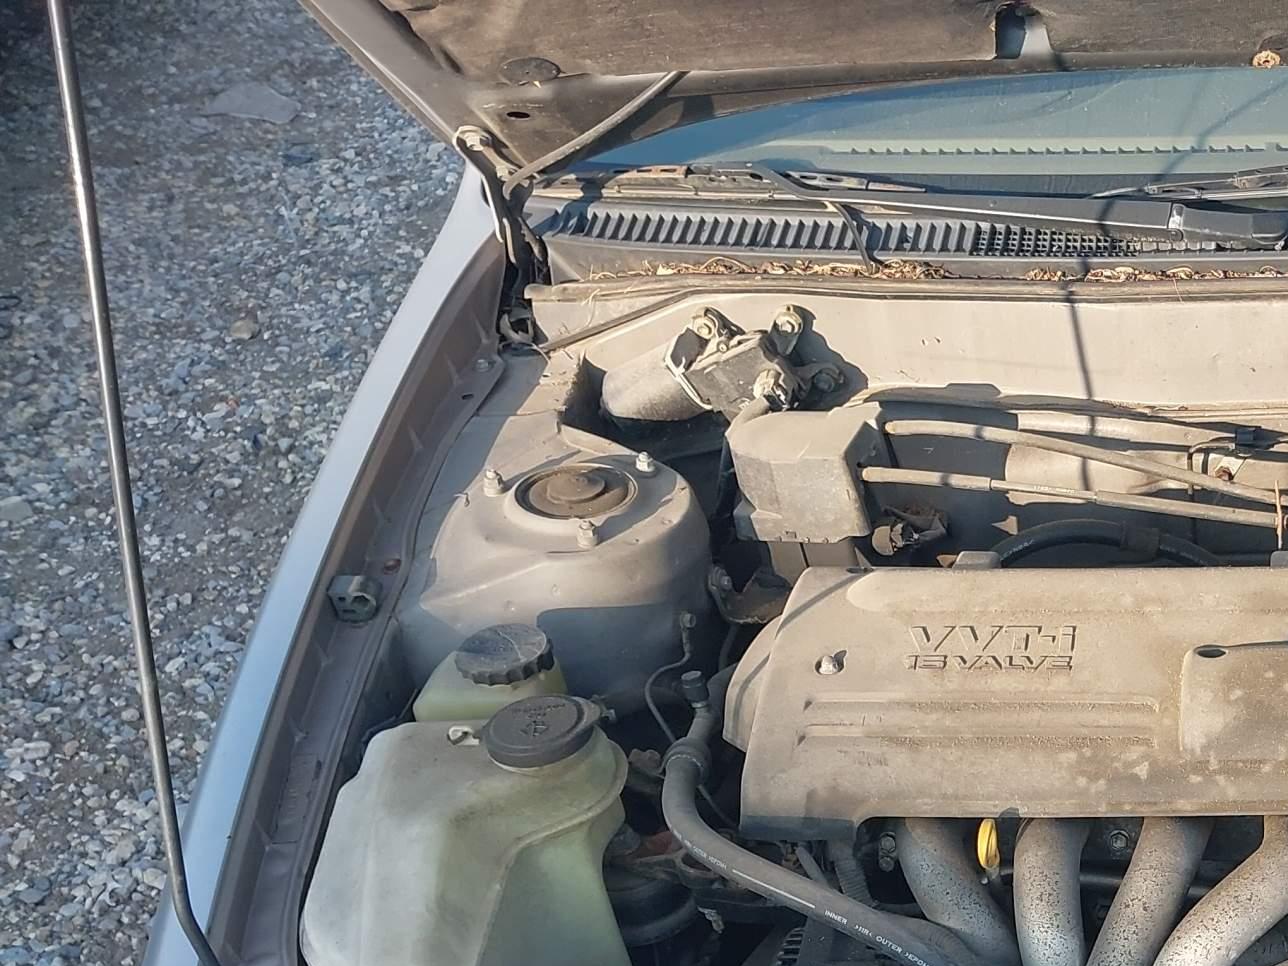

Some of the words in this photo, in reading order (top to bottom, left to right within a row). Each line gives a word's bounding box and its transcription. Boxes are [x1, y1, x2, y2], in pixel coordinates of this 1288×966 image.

[952, 654, 1073, 671] VALVE
[824, 909, 848, 925] INNER
[875, 935, 903, 954] OUTER
